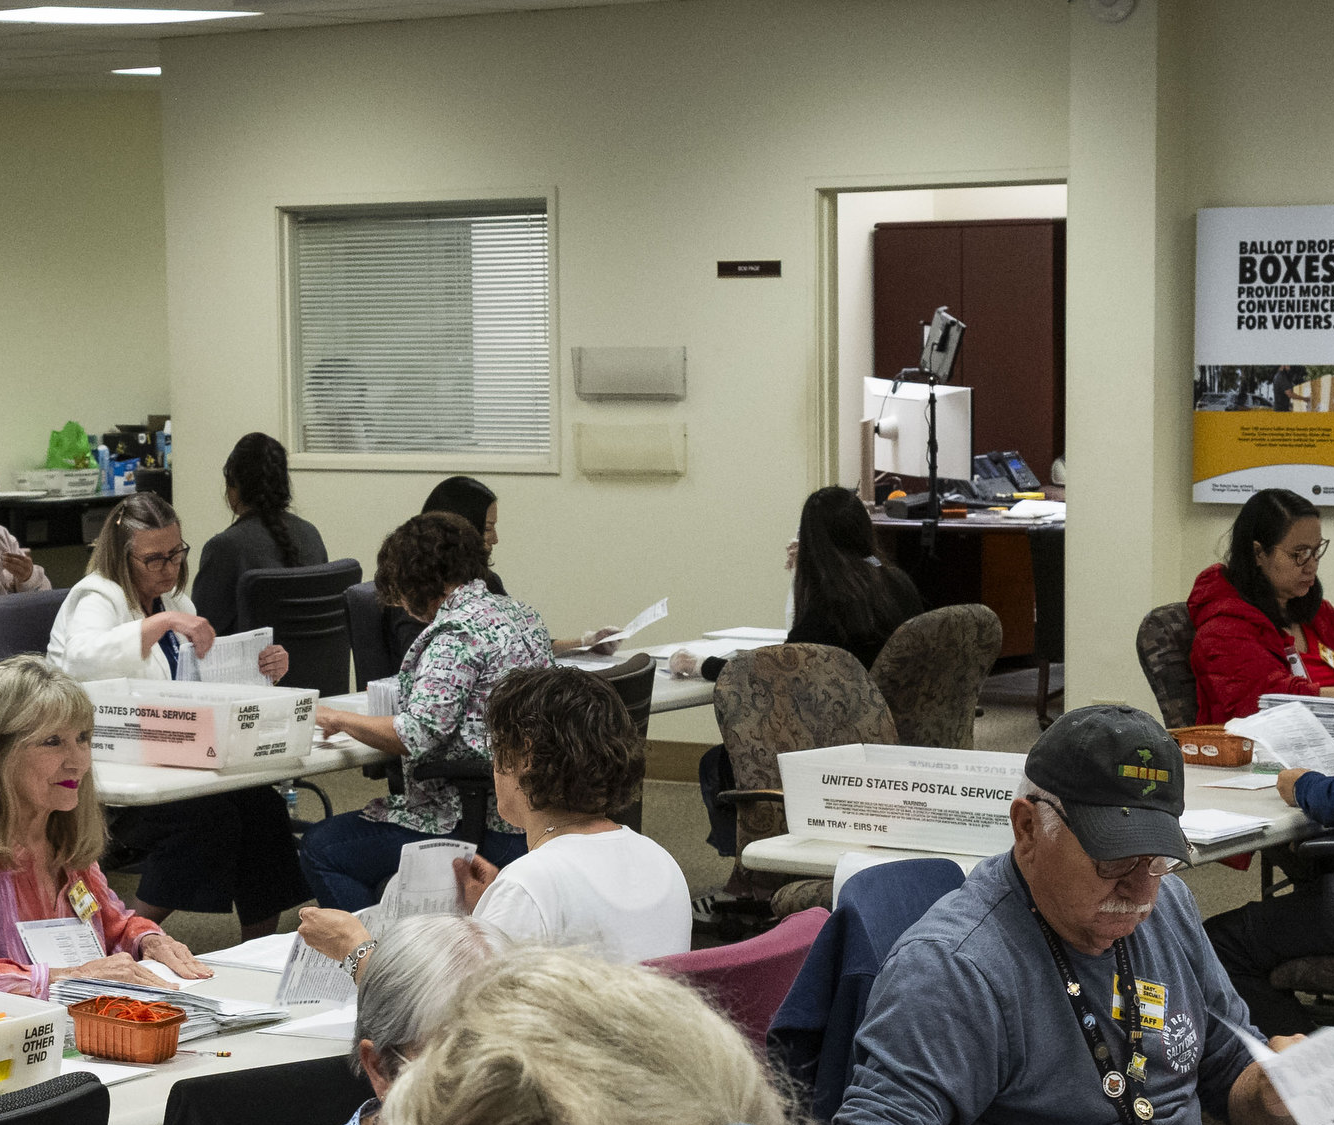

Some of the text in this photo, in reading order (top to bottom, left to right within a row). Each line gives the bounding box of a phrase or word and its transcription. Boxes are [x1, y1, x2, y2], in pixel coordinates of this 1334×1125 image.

[1239, 240, 1294, 255] BALLOT
[1237, 285, 1295, 299] PROVIDE
[1237, 314, 1268, 330] FOR
[239, 704, 260, 714] LABEL
[295, 697, 313, 707] LABEL
[98, 705, 197, 722] STATES POSTAL SERVICE
[237, 712, 260, 722] OTHER
[294, 705, 313, 716] OTHER
[296, 713, 309, 723] END
[240, 721, 255, 730] END
[821, 773, 1013, 801] UNITED STATES POSTAL SERVICE
[807, 817, 826, 827] EMM
[826, 819, 847, 830] TRAY
[853, 822, 872, 832] EIRS
[873, 824, 888, 834] 74E
[24, 1022, 54, 1040] LABEL
[22, 1035, 55, 1053] OTHER
[26, 1050, 48, 1066] END
